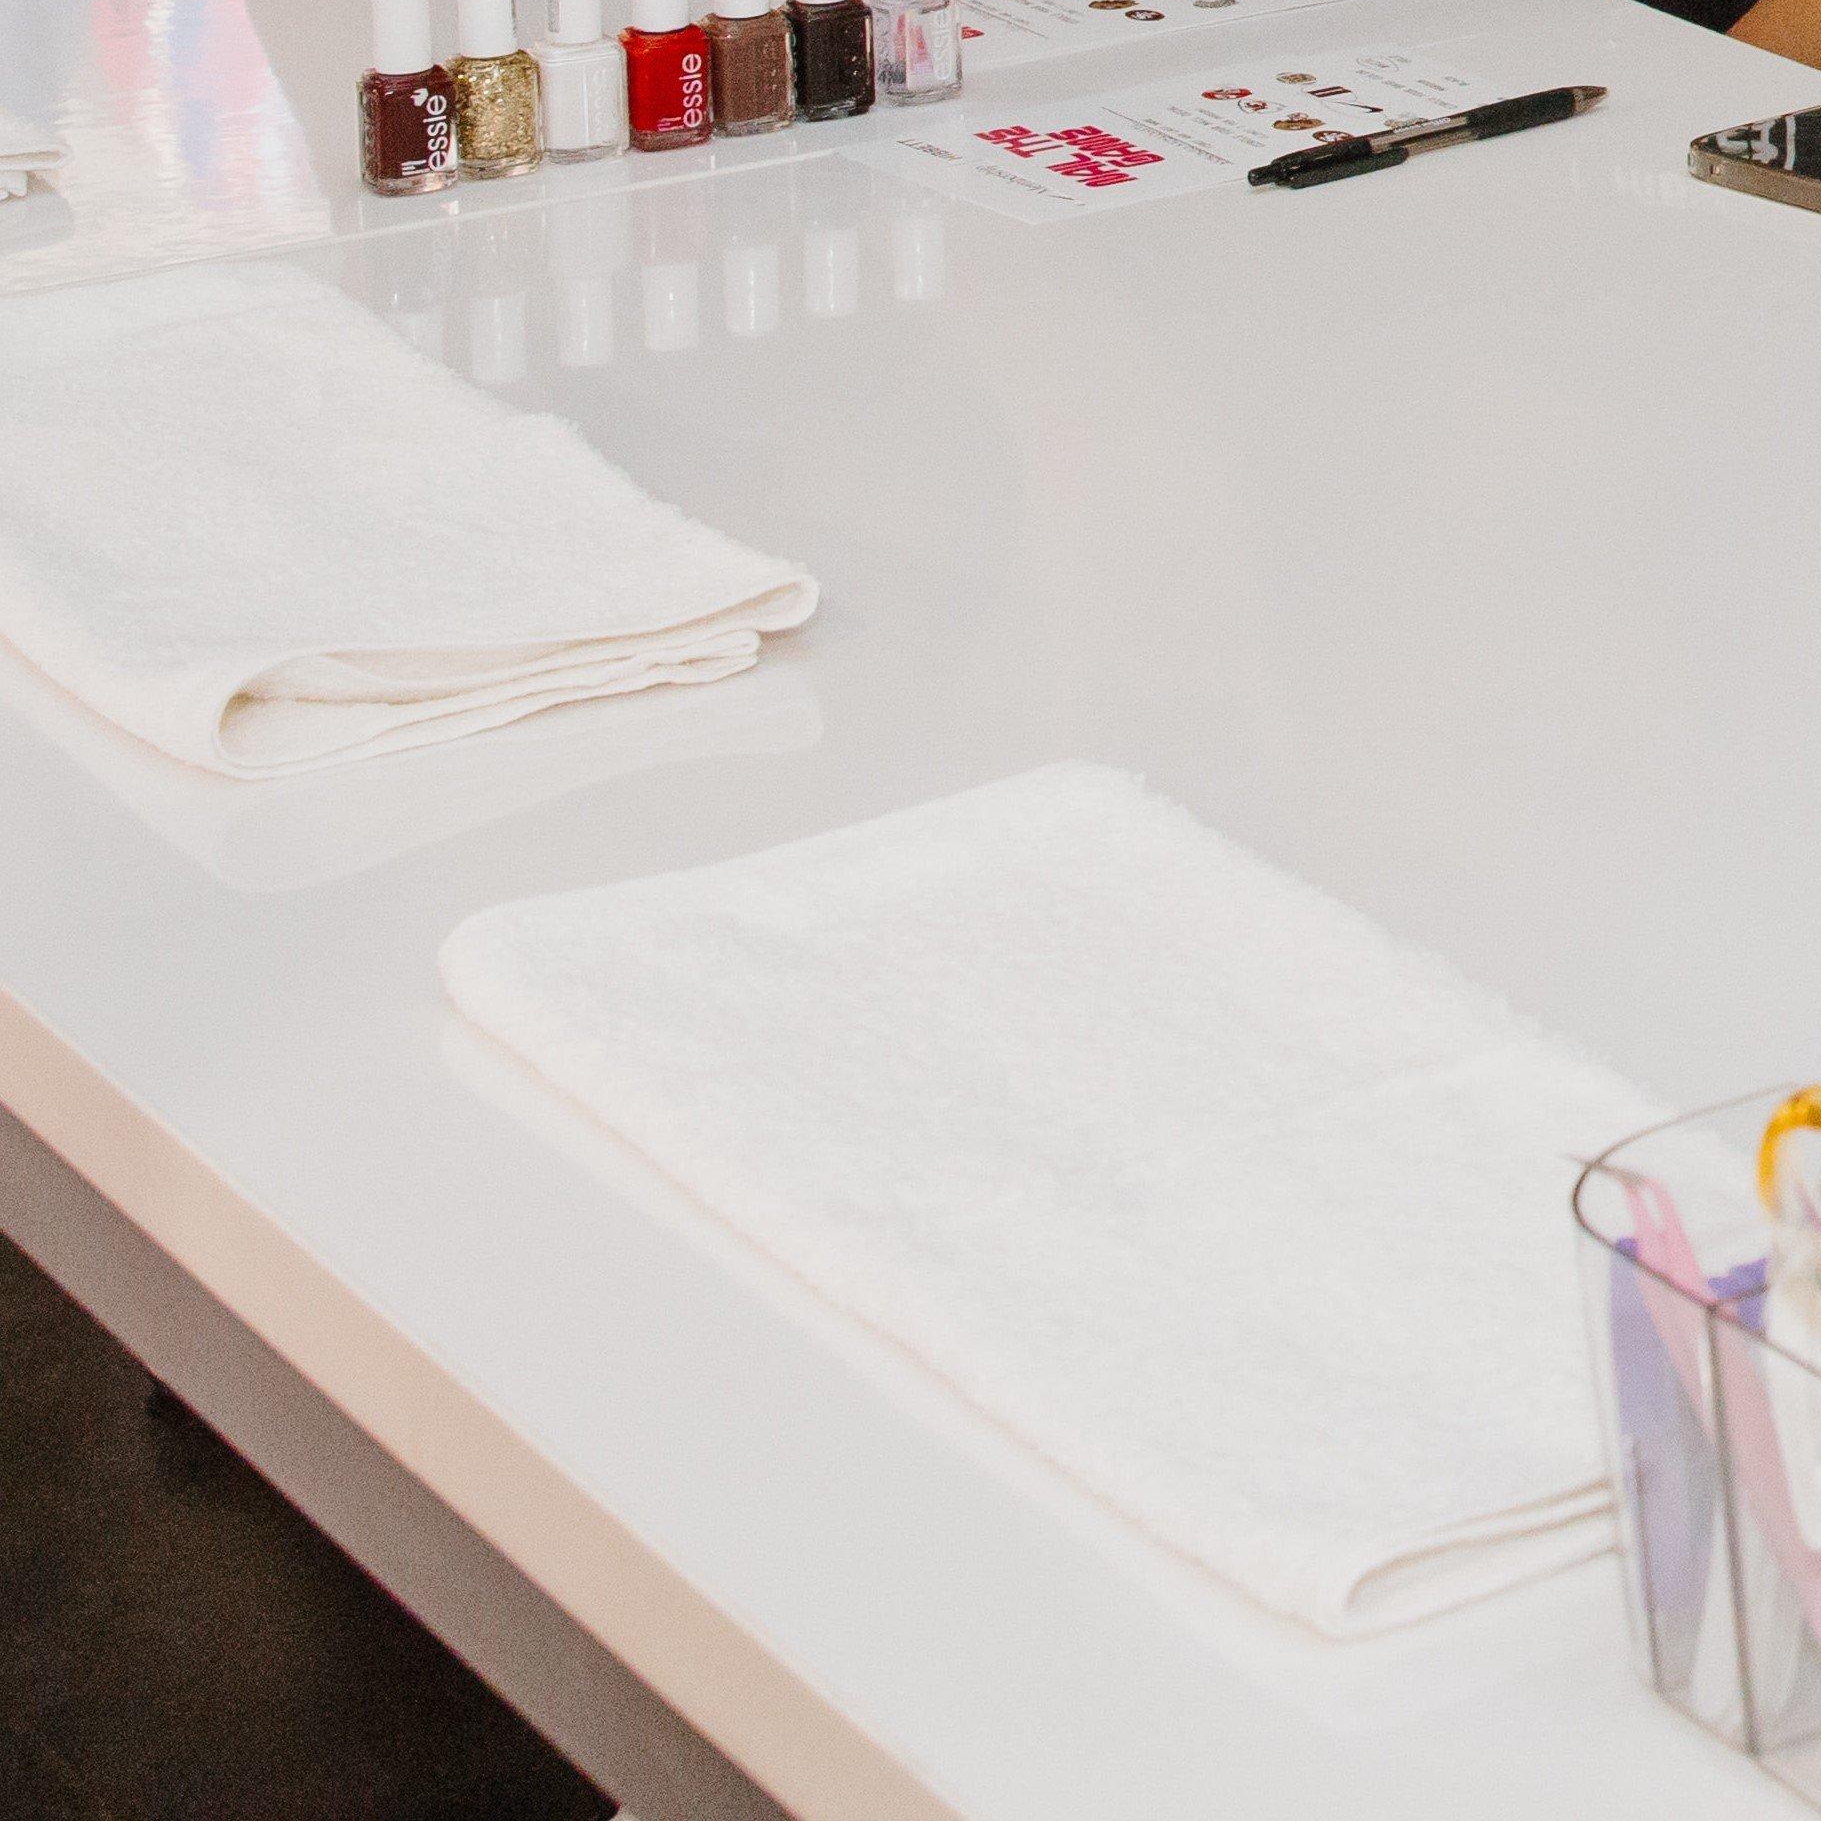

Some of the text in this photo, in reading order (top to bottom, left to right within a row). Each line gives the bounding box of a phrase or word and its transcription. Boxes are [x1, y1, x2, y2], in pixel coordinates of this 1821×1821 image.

[679, 54, 703, 129] essie
[423, 93, 447, 172] essie
[1045, 125, 1165, 168] GAME
[1046, 152, 1140, 188] NAIL
